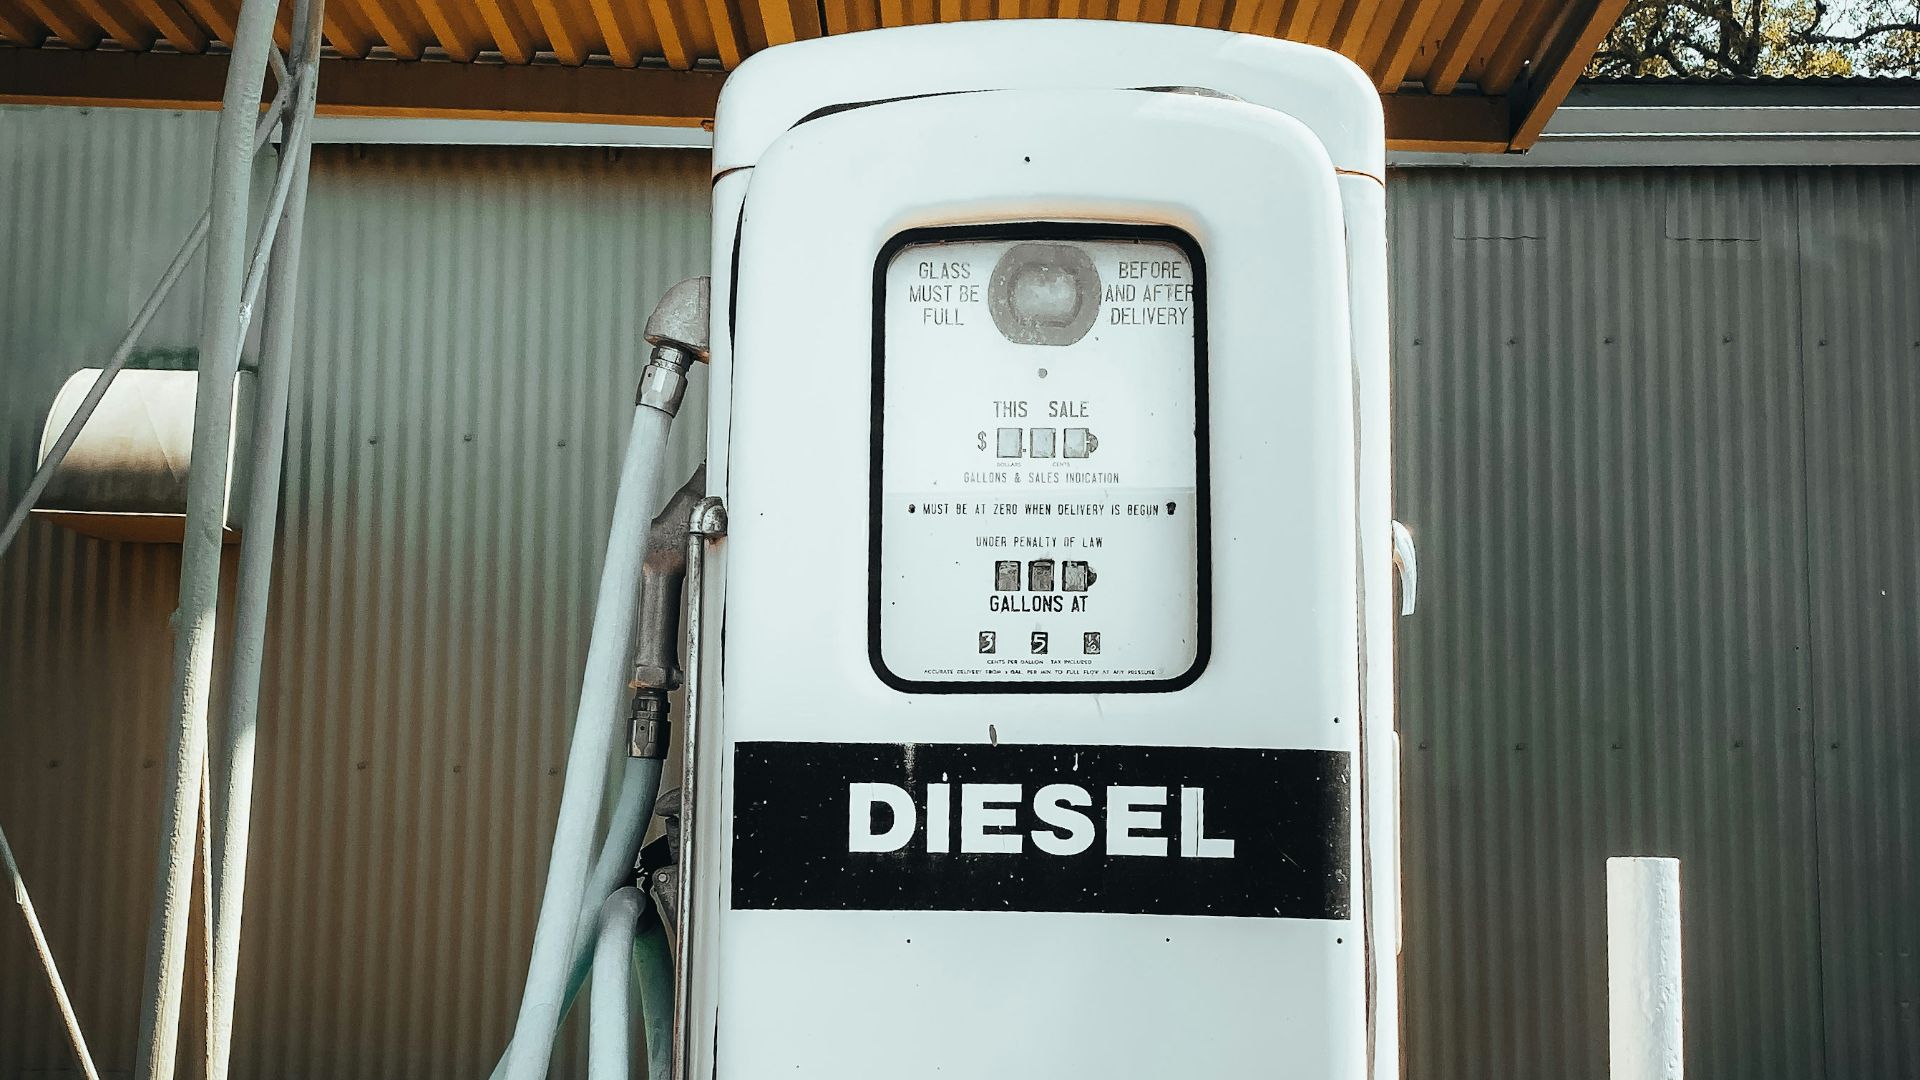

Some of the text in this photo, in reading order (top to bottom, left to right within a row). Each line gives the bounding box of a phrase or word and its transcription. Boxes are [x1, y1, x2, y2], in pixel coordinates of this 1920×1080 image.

[918, 261, 971, 279] GLASS
[1118, 261, 1181, 279] BEFORE
[909, 285, 980, 302] MUST BE
[1105, 284, 1193, 301] AND AFTER
[923, 308, 964, 325] FULL
[1110, 308, 1188, 325] DELIVERY
[993, 401, 1090, 418] THIS SALE
[977, 430, 987, 451] $
[963, 472, 1120, 484] GALLONS & SALES INDICATION
[922, 503, 1160, 516] MUST BE AT ZERO WHEN DELIVERY IS BEGUN
[975, 536, 1104, 548] UNDER PENALTY OF LAW
[989, 595, 1089, 613] GALLONS AT
[981, 632, 993, 652] 3
[1033, 633, 1046, 653] 5
[848, 782, 1235, 859] DIESEL
